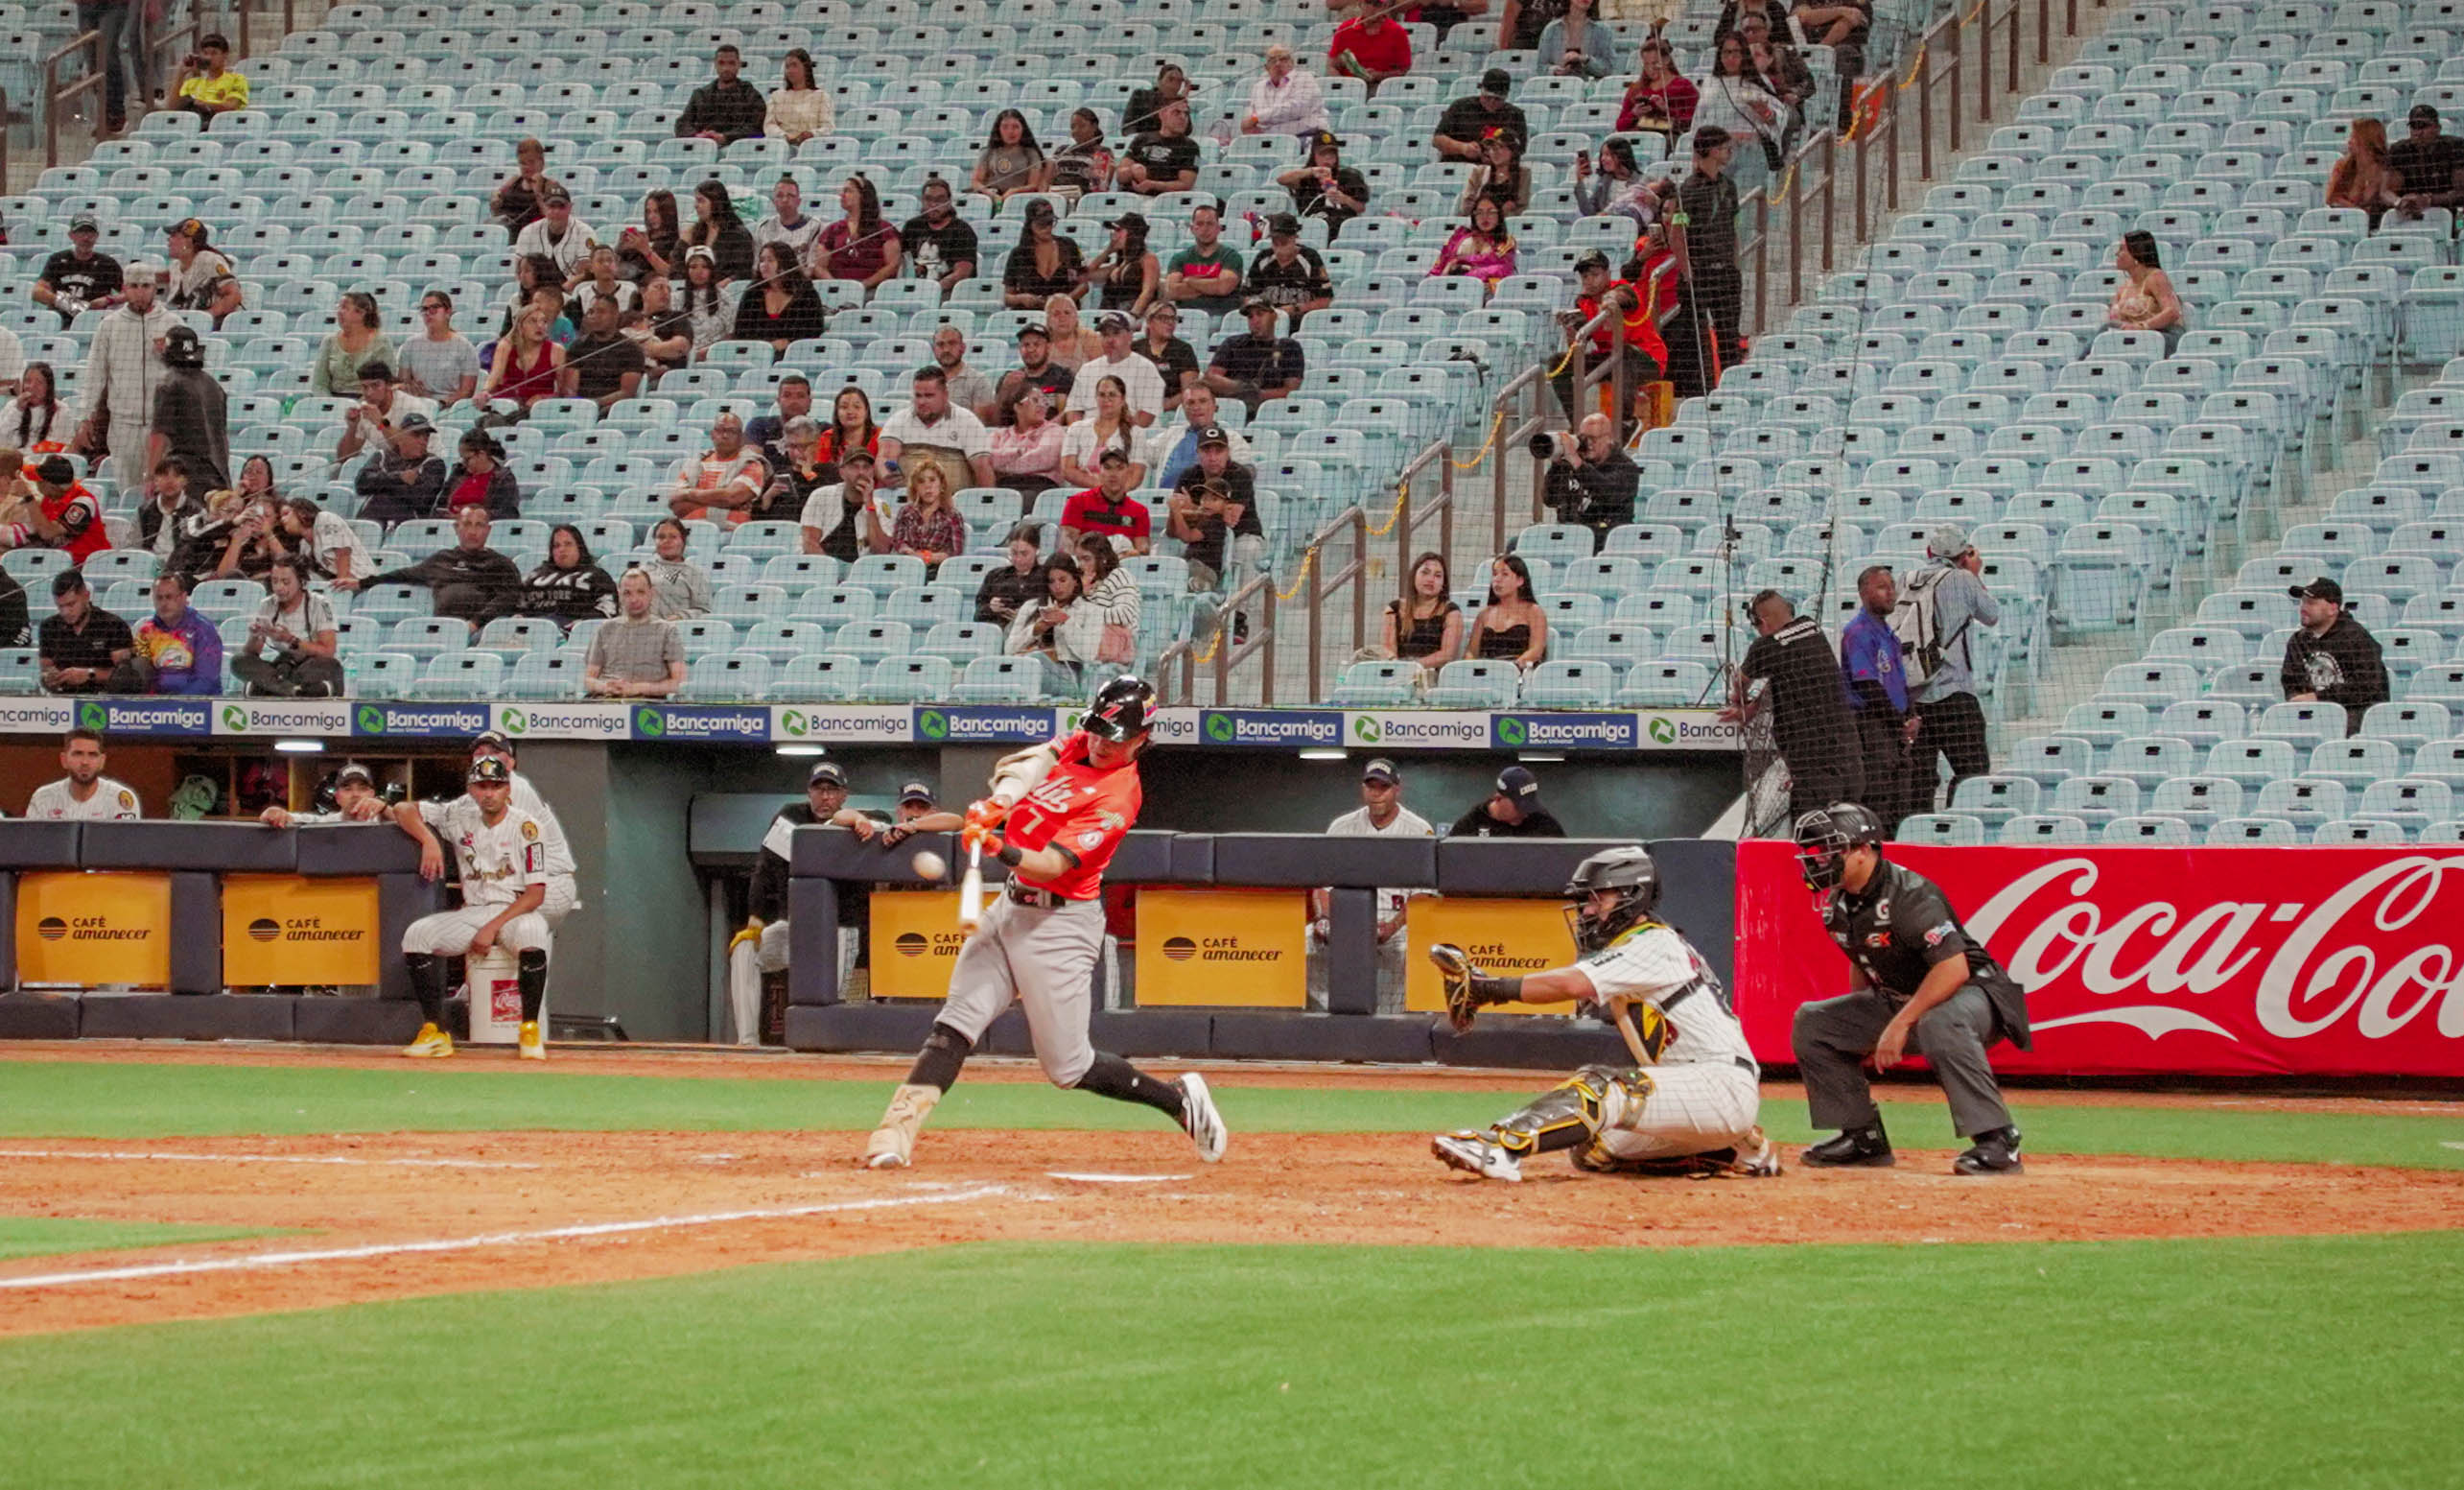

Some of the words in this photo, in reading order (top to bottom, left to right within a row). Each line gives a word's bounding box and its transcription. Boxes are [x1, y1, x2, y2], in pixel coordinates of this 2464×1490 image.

[109, 706, 204, 729] Bancamiga
[251, 710, 346, 731] Bancamiga
[387, 710, 482, 731] Bancamiga
[529, 713, 624, 733] Bancamiga
[666, 713, 763, 734] Bancamiga
[811, 714, 907, 735] Bancamiga
[950, 715, 1048, 736] Bancamiga
[1236, 719, 1335, 741] Bancamiga
[1385, 721, 1484, 741] Bancamiga
[1529, 721, 1630, 742] Bancamiga
[1021, 807, 1044, 836] 7
[72, 915, 106, 928] CAFÉ
[286, 916, 321, 929] CAFÉ
[72, 929, 152, 940] amanecer
[286, 930, 364, 941] amanecer
[1202, 936, 1238, 949] CAFÉ
[1202, 950, 1283, 961] amanecer
[1468, 942, 1505, 956] CAFÉ
[1962, 855, 2464, 1038] Coca-Co
